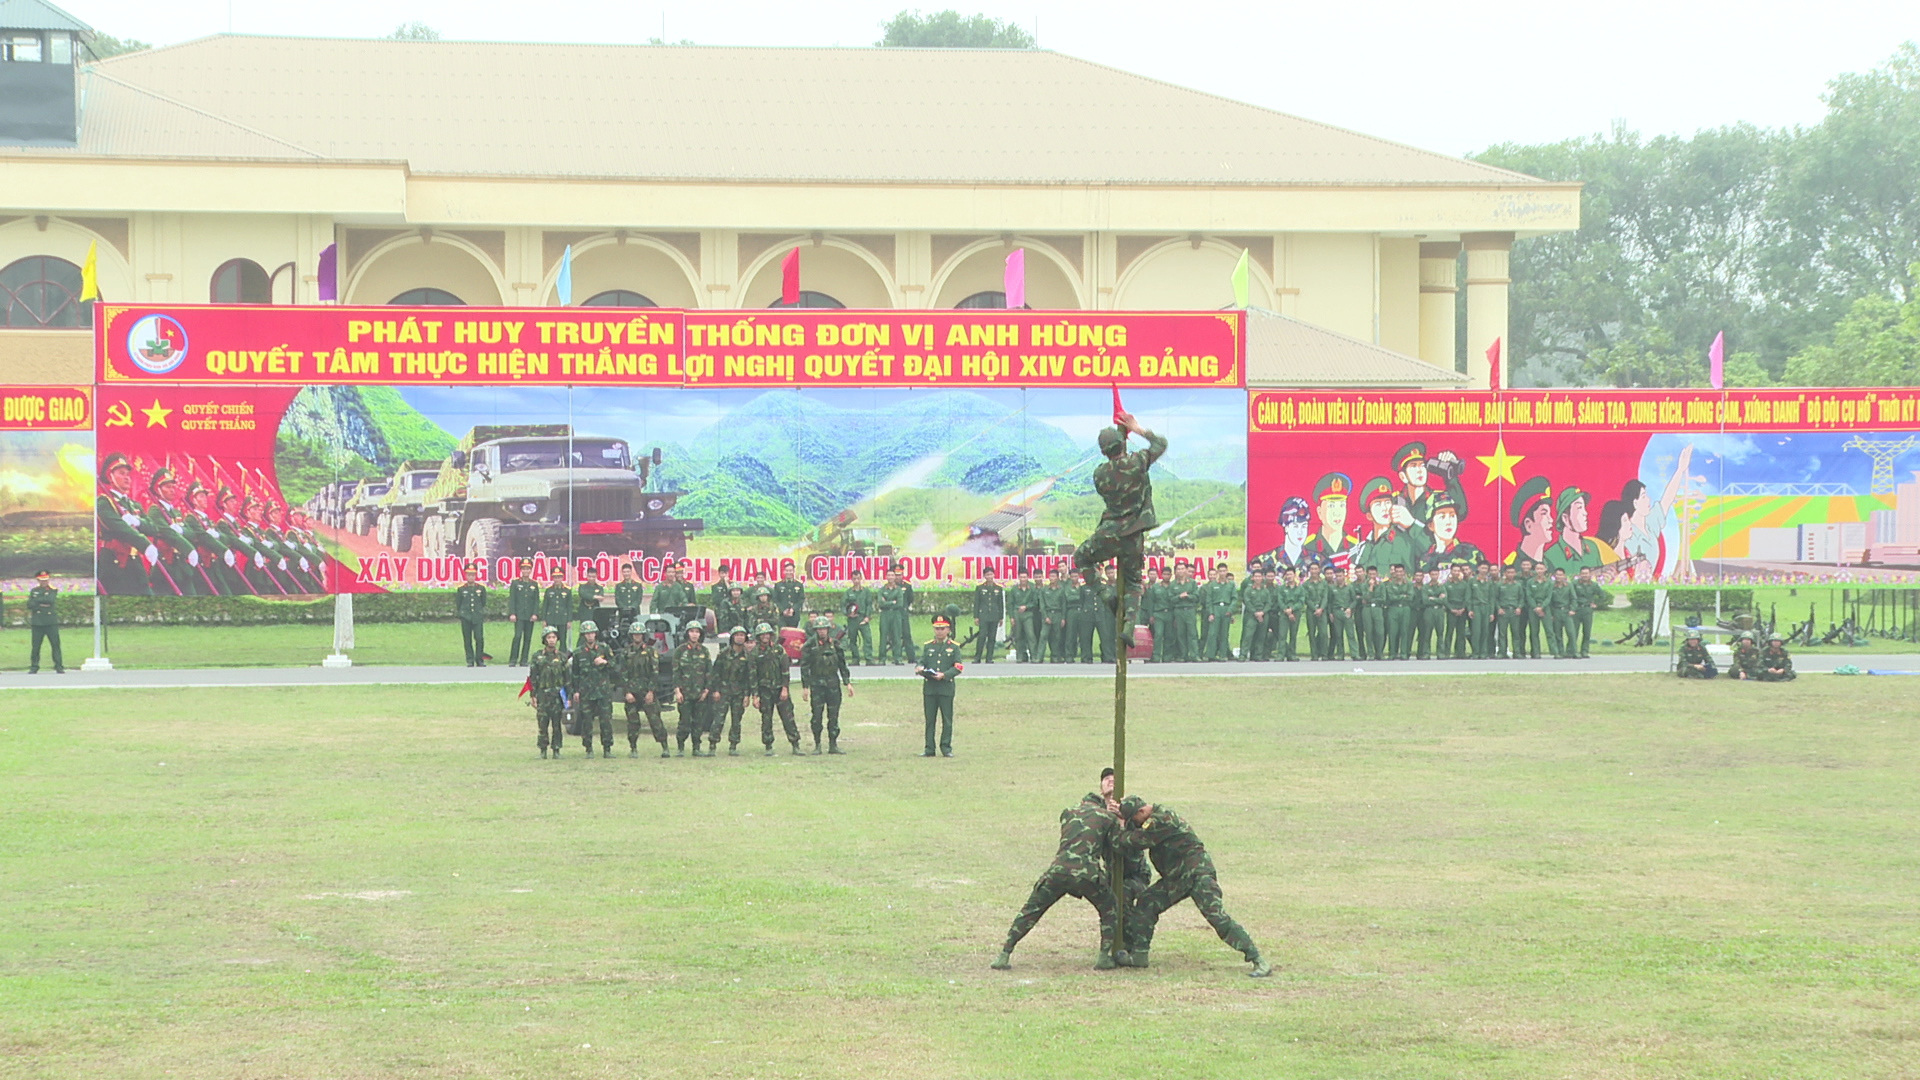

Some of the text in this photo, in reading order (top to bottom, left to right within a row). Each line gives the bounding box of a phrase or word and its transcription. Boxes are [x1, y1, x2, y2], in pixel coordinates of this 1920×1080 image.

[348, 314, 1128, 351] PHÁT HUY TRUYỀN THỐNG ĐƠN VỊ ANH HÙNG
[205, 343, 304, 376] QUYẾT
[312, 346, 380, 374] TÂM
[388, 349, 469, 379] THỰC
[477, 347, 549, 380] HIỆN
[557, 345, 659, 376] THẮNG
[667, 353, 715, 382] LỢI
[723, 353, 795, 382] NGHỊ
[803, 347, 896, 379] QUYẾT
[902, 354, 952, 382] ĐẠI
[961, 350, 1010, 382] HỘI
[1018, 354, 1067, 378] XIV
[1072, 346, 1132, 378] CỦA
[1138, 346, 1220, 378] ĐẢNG
[3, 395, 84, 427] ĐƯỢC GIAO
[181, 415, 256, 430] QUYẾT THẮNG
[183, 400, 255, 415] QUYẾT CHIẾN
[1257, 396, 1279, 425] CÁN
[1280, 396, 1297, 430] BỘ,
[1298, 396, 1325, 426] ĐOÀN
[1327, 396, 1350, 425] VIÊN
[1350, 396, 1365, 425] LỮ
[1366, 396, 1392, 425] ĐOÀN
[1394, 401, 1412, 425] 368
[1414, 401, 1446, 425] TRUNG
[1447, 396, 1483, 427] THÀNH,
[1484, 392, 1506, 425] BẢN
[1508, 396, 1534, 427] LĨNH,
[1535, 392, 1552, 424] ĐỔI
[1553, 394, 1576, 427] MỚI,
[1578, 396, 1605, 424] SÁNG
[1606, 400, 1628, 429] TẠO,
[1630, 401, 1657, 424] XUNG
[1658, 396, 1685, 427] KÍCH,
[1686, 396, 1714, 424] DŨNG
[1715, 392, 1743, 426] CẢM,
[1744, 394, 1771, 424] XỨNG
[1806, 394, 1821, 428] BỘ
[1822, 394, 1840, 428] ĐỘI
[1841, 399, 1856, 428] CỤ
[1878, 393, 1900, 422] THỜI
[1901, 393, 1915, 422] KỲ
[358, 553, 408, 582] XÂY
[417, 555, 488, 587] DỰNG
[812, 552, 889, 581] CHÍNH
[899, 556, 953, 584] QUY,
[962, 556, 1018, 580] TINH
